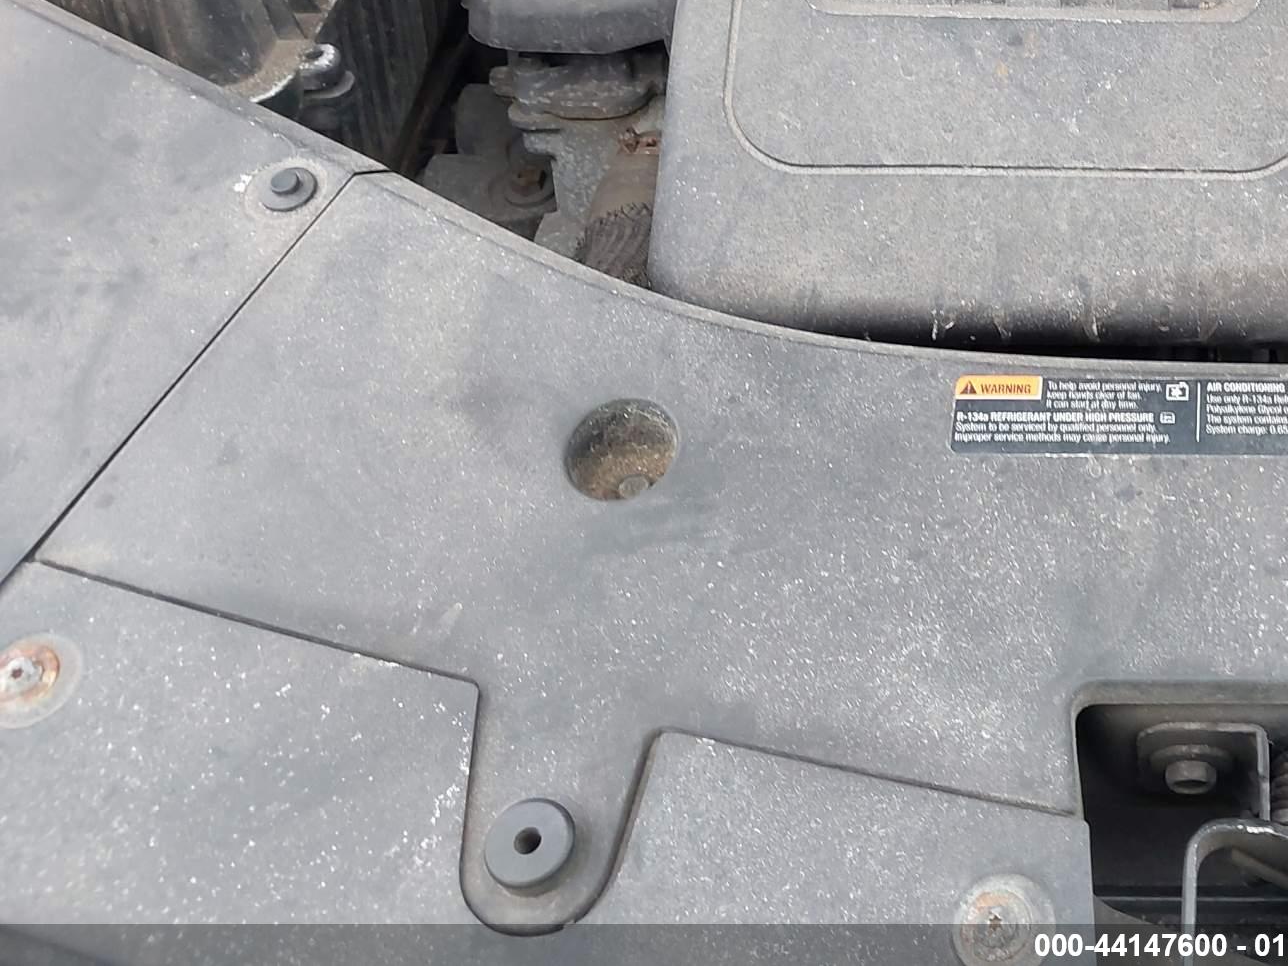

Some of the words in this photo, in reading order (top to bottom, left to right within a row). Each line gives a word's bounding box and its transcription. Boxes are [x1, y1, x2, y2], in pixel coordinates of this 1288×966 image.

[981, 384, 1031, 394] WARNING
[1102, 382, 1136, 392] personal
[1207, 383, 1221, 392] AIR
[1224, 383, 1285, 393] CONDITIONING
[1243, 395, 1272, 404] R-134a
[956, 412, 988, 421] R-134a
[991, 412, 1051, 422] REFRIGERANT
[1053, 412, 1083, 422] UNDER
[1085, 412, 1107, 422] HIGH
[1109, 412, 1154, 423] PRESSURE
[1223, 415, 1252, 424] system
[1254, 415, 1288, 424] contains
[956, 422, 986, 432] System
[1011, 423, 1046, 431] serviced
[1060, 423, 1095, 433] qualified
[1097, 424, 1136, 433] personnel
[1206, 424, 1236, 434] System
[955, 433, 992, 442] Improper
[1026, 433, 1061, 442] methods
[1109, 434, 1144, 444] personal
